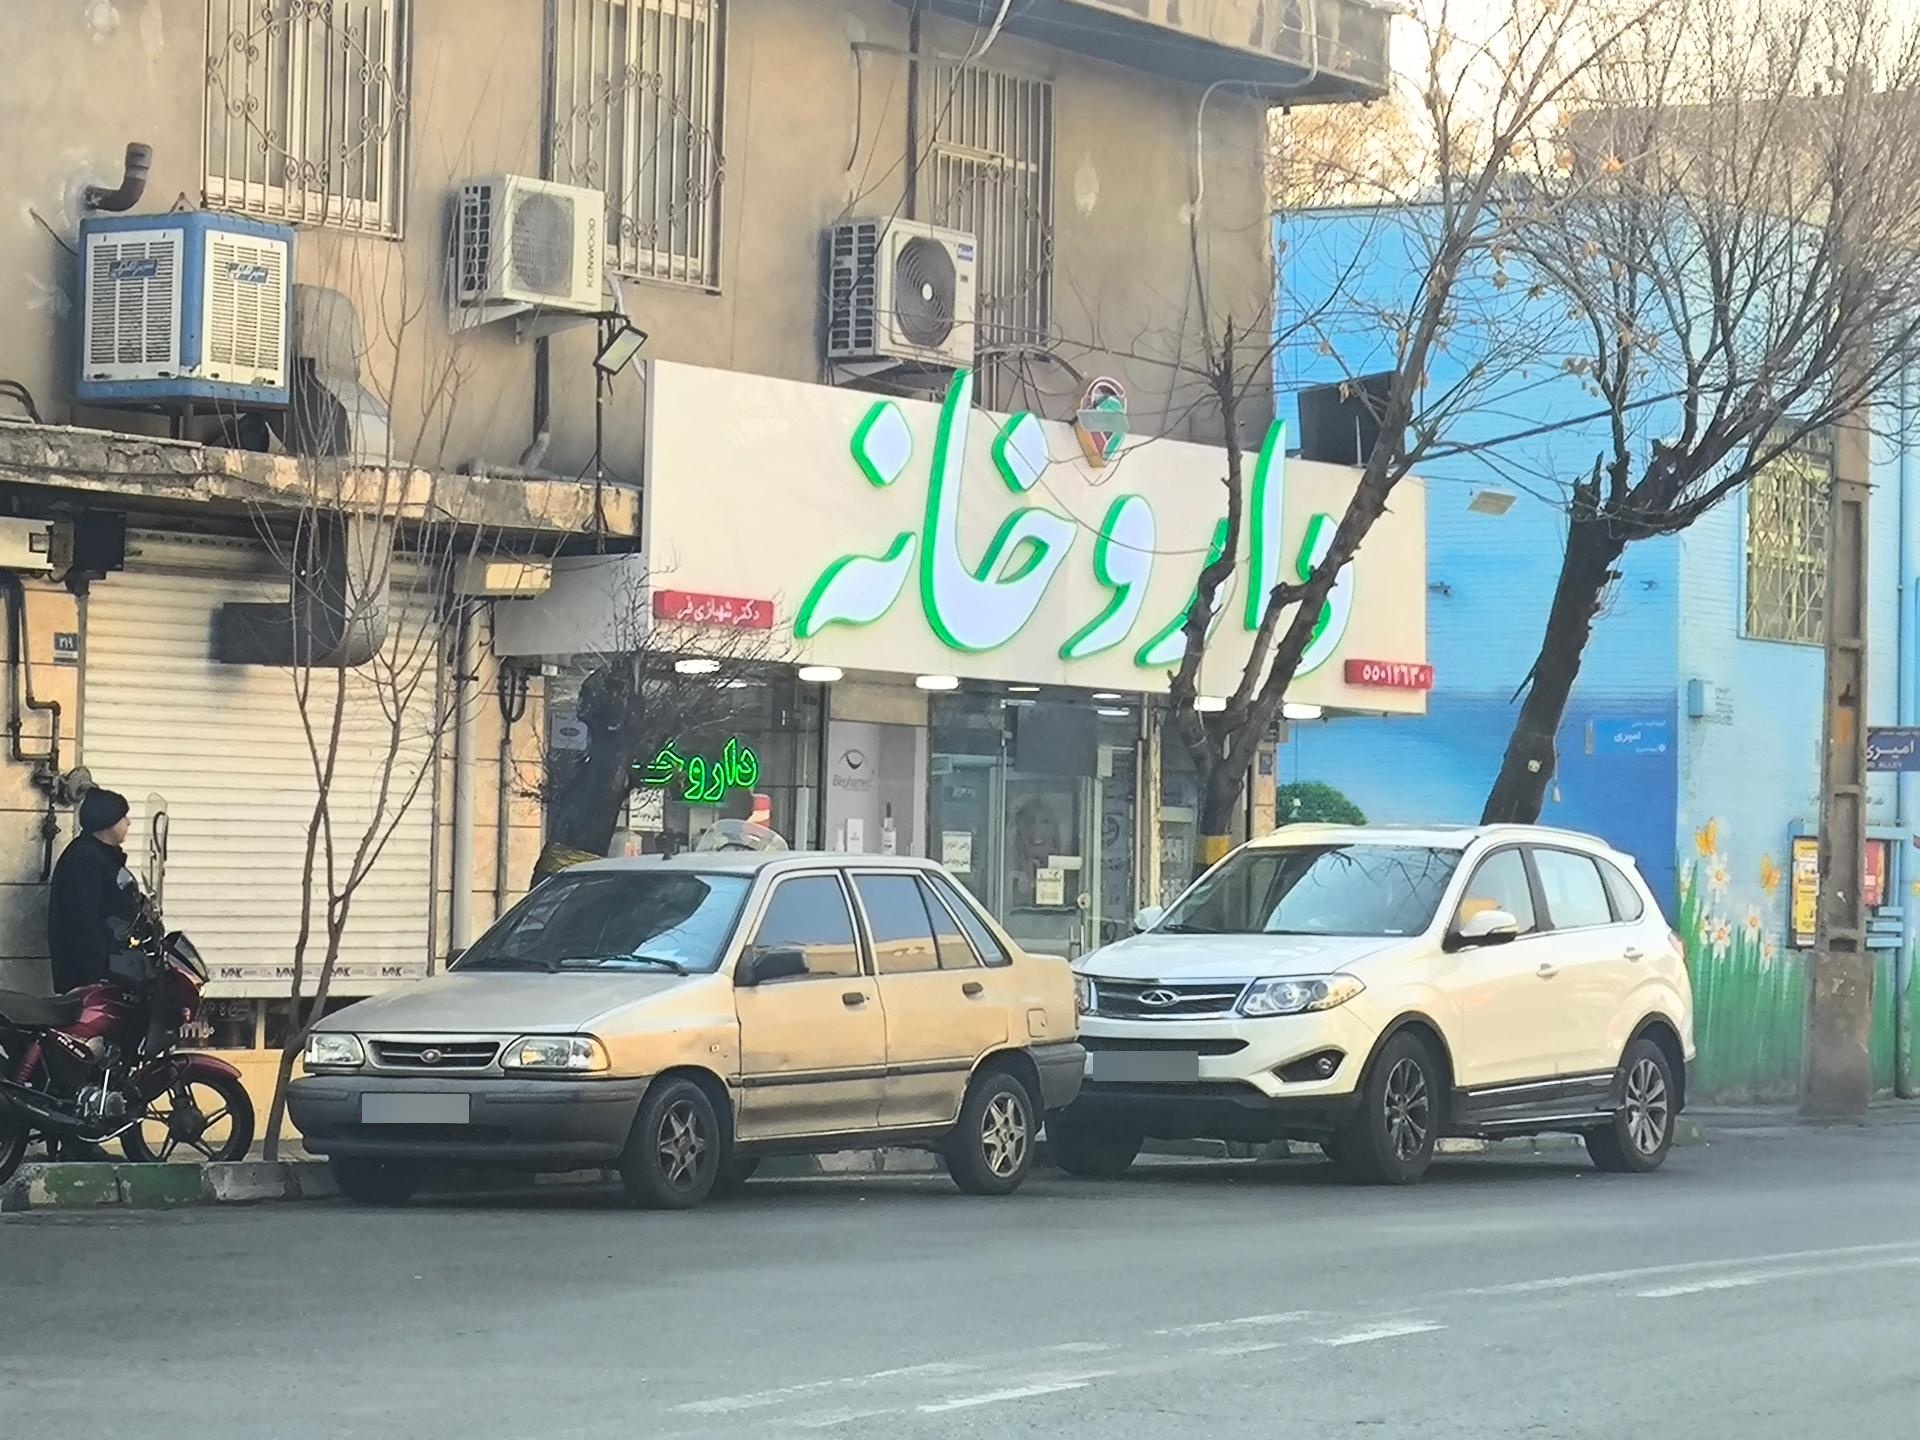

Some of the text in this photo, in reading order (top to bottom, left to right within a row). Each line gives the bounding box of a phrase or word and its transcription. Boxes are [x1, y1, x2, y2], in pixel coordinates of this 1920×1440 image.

[587, 217, 597, 288] KENWOOD
[793, 368, 1355, 679] داروخانه
[732, 599, 760, 626] دکتر
